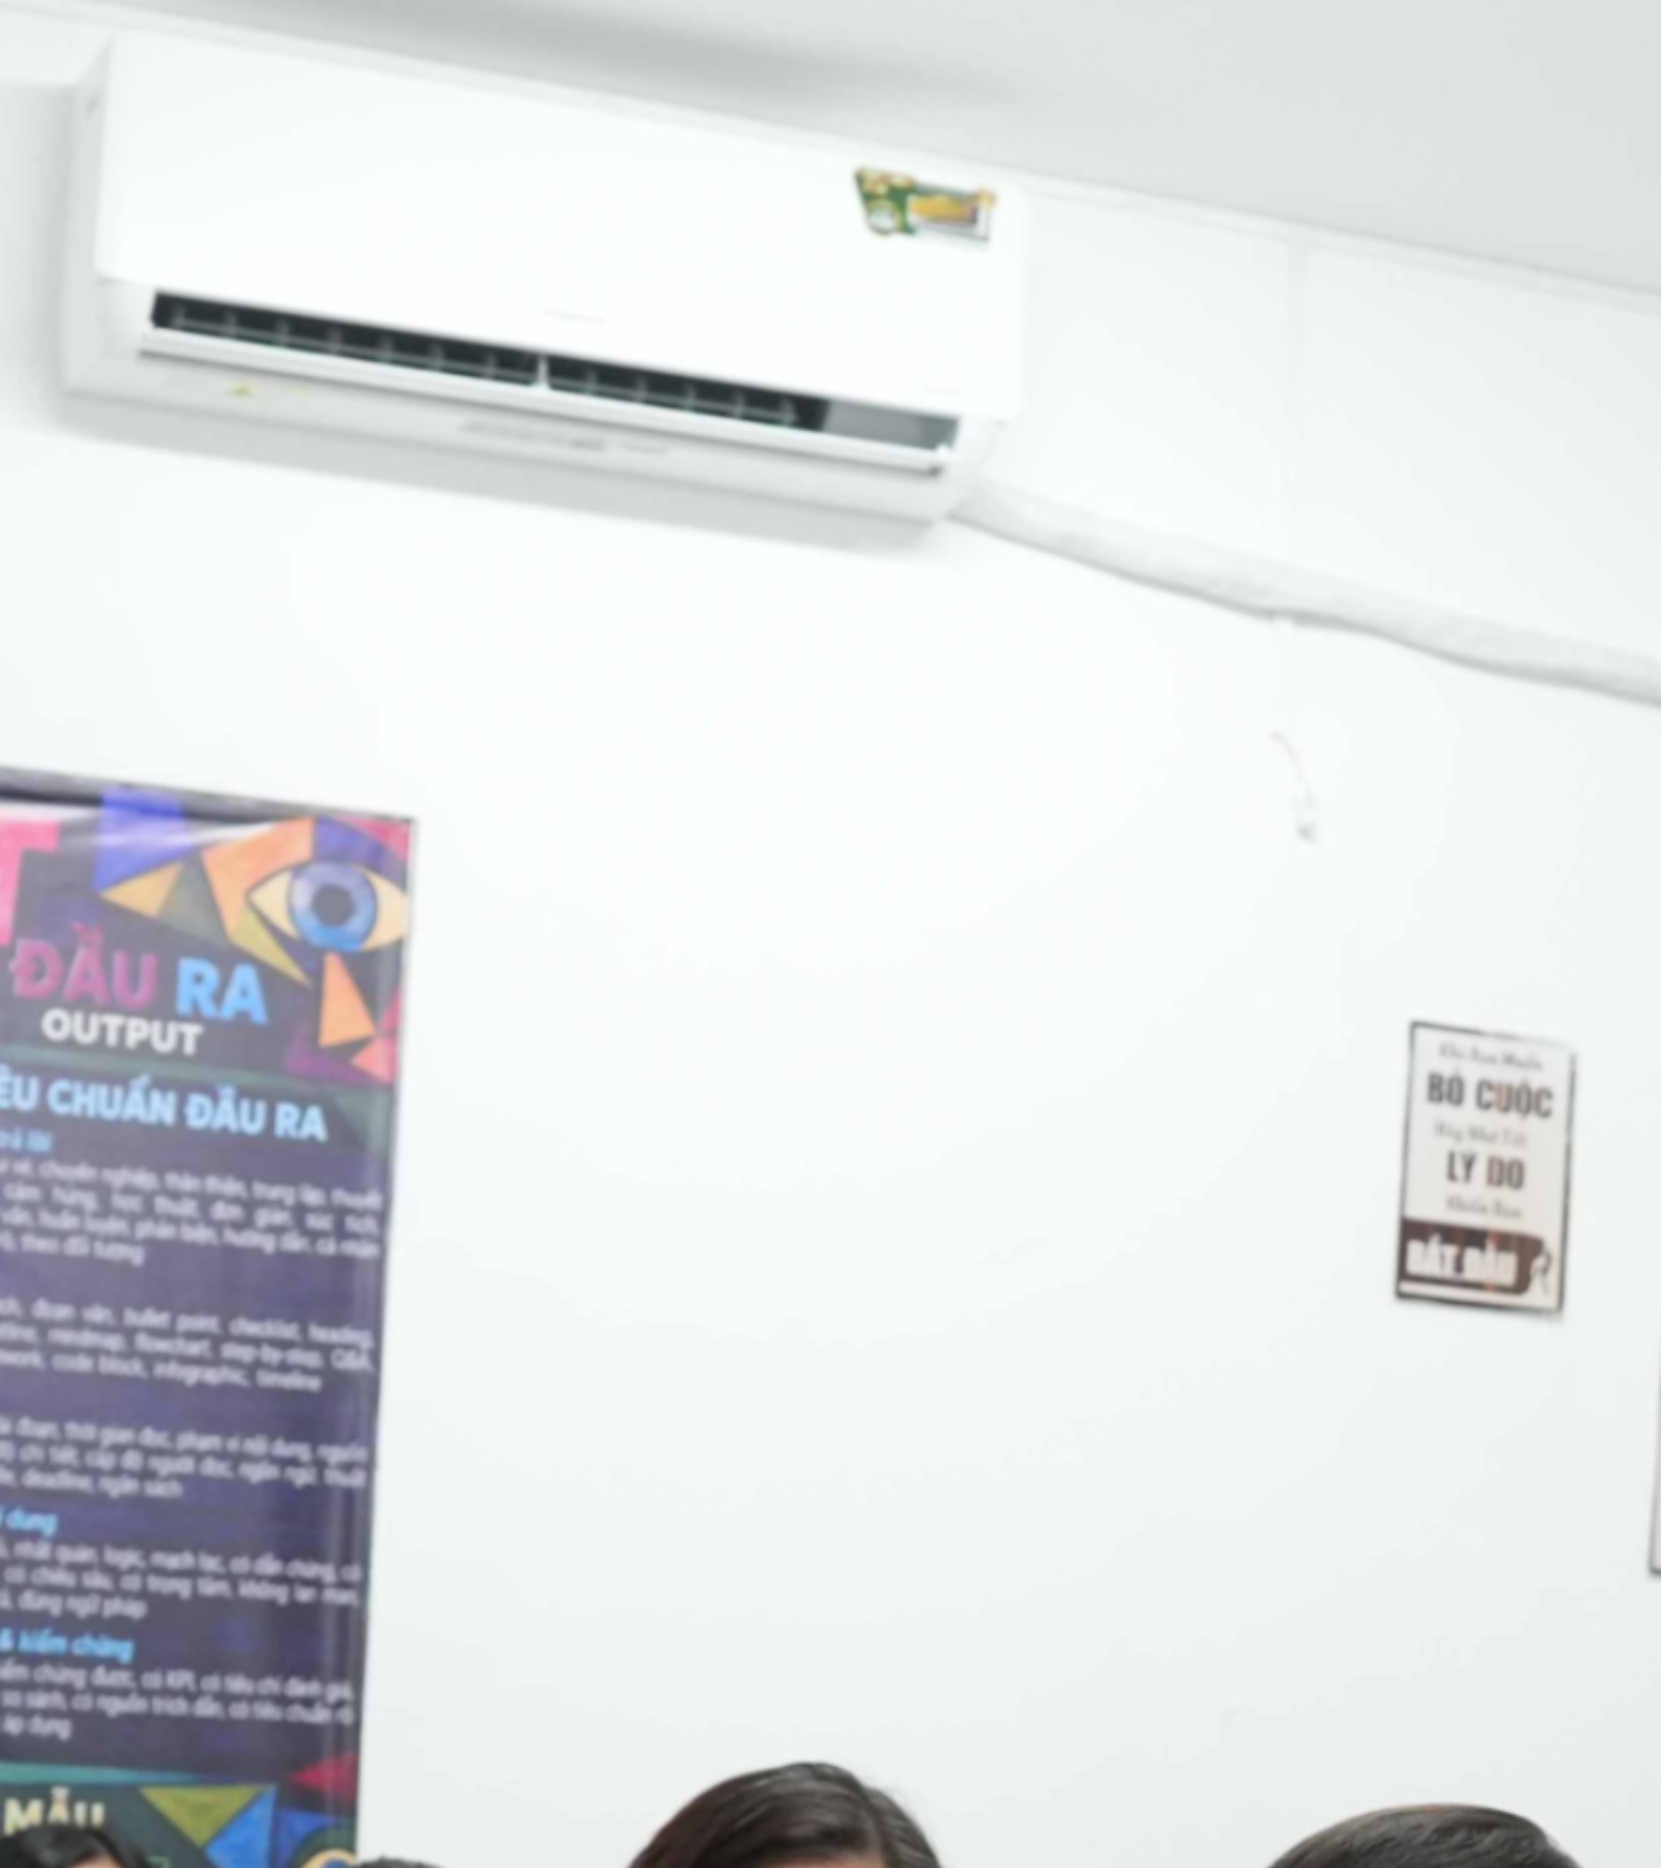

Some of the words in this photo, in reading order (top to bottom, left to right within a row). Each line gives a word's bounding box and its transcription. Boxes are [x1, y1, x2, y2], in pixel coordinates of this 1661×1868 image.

[8, 922, 158, 1010] ĐẦU
[175, 957, 269, 1027] RA
[41, 1008, 204, 1056] OUTPUT
[46, 1075, 178, 1125] CHUẨN
[183, 1085, 265, 1135] ĐẦU
[273, 1105, 329, 1141] RA
[1486, 1156, 1525, 1190] DO
